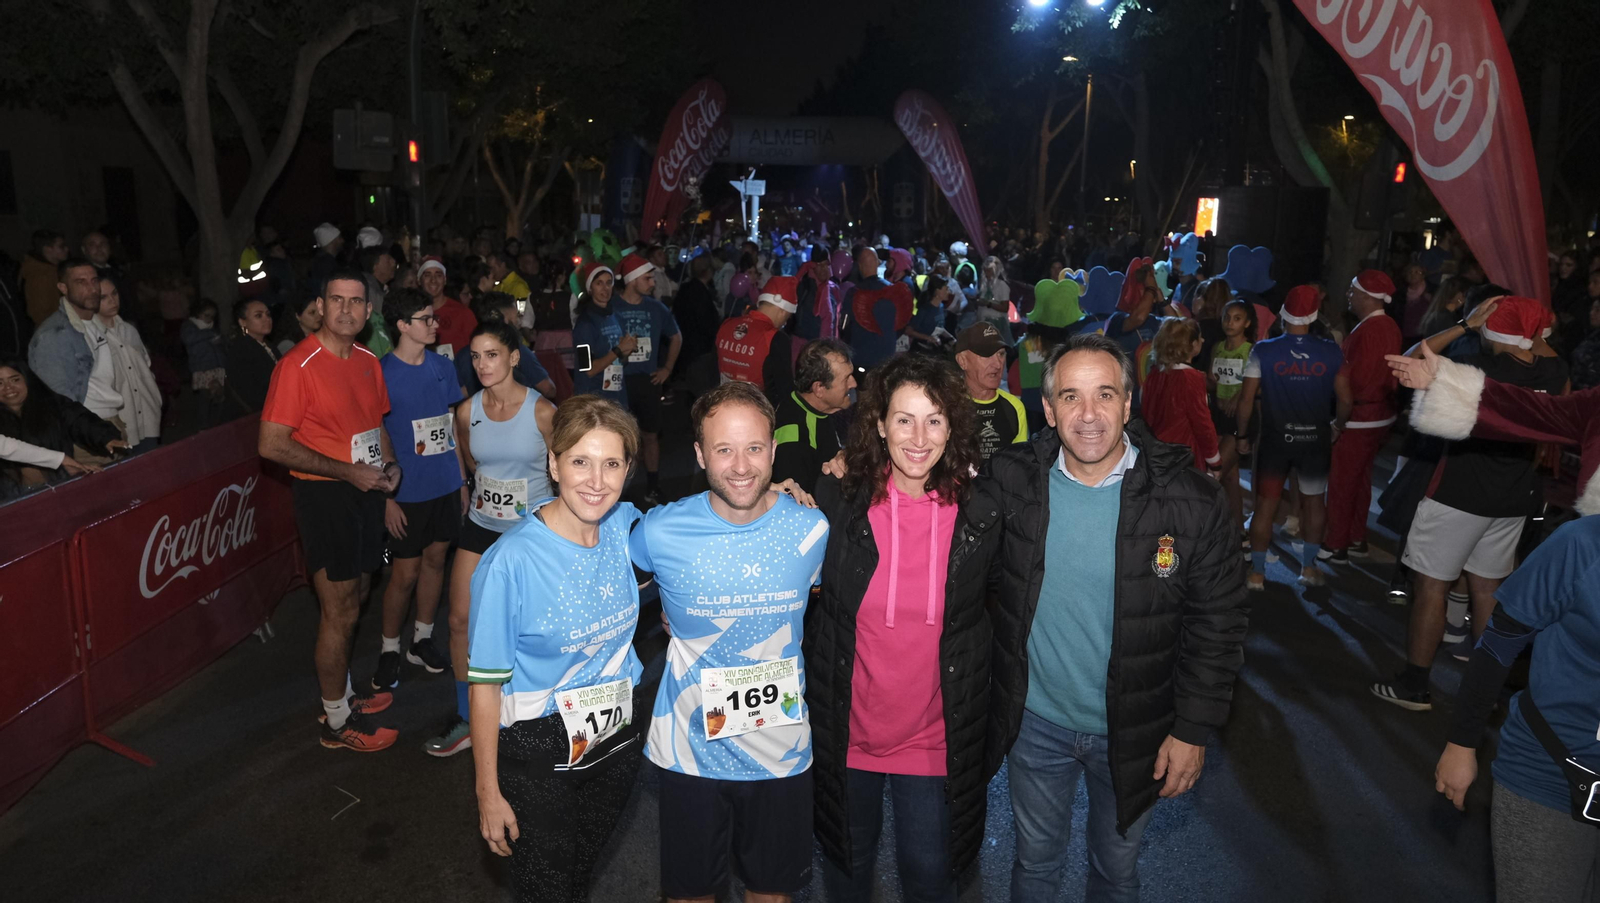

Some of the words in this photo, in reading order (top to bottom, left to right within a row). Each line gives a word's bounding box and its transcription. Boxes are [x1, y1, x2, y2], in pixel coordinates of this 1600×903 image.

[658, 84, 720, 192] Coca-Cola
[750, 126, 835, 145] ALMERÍA
[719, 339, 755, 356] GALGOS
[1217, 367, 1234, 377] 943
[1273, 361, 1327, 376] GALO
[430, 428, 445, 441] 55
[368, 443, 381, 458] 56
[483, 489, 513, 505] 502
[139, 474, 258, 599] Coca-Cola
[697, 595, 731, 605] CLUB
[733, 589, 798, 604] ATLETISMO
[686, 604, 788, 618] PARLAMENTARIO
[569, 622, 600, 640] CLUB
[723, 669, 737, 678] XIV
[738, 667, 754, 677] SAN
[754, 659, 793, 673] SILVESTRE
[725, 676, 752, 686] CIUDAD
[753, 674, 763, 682] DE
[577, 689, 590, 699] XIV
[590, 686, 606, 696] SAN
[579, 695, 606, 708] CIUDAD
[606, 693, 615, 702] DE
[727, 684, 779, 711] 169
[585, 706, 623, 735] 170
